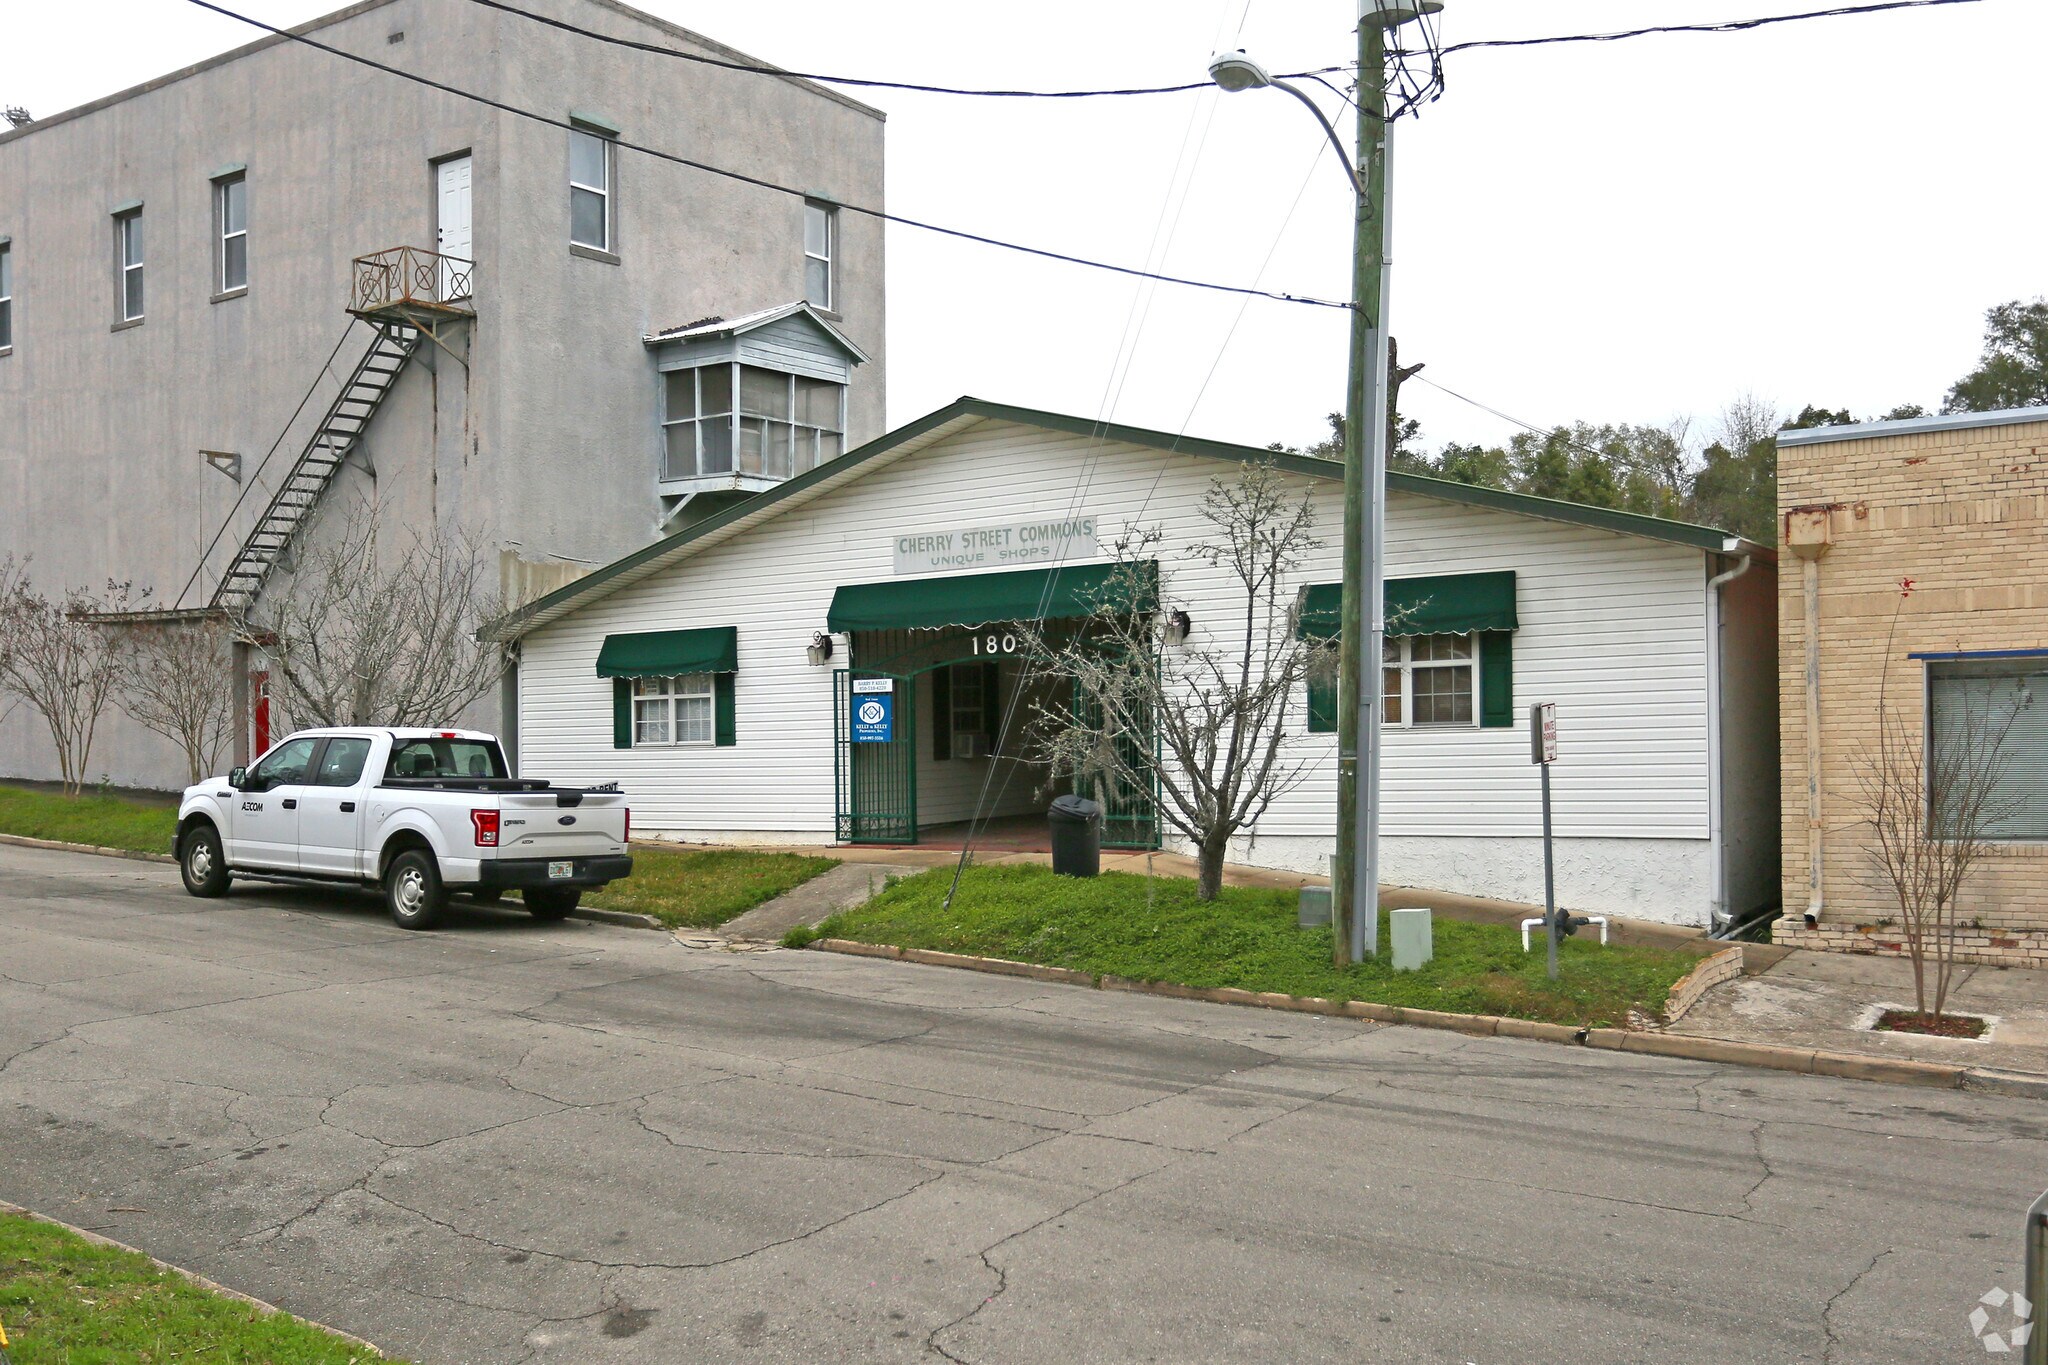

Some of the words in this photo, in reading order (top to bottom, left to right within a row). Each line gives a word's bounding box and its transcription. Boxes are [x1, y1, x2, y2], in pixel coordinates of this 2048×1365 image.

[899, 534, 953, 554] CHERRY
[962, 528, 1012, 549] STREET
[1019, 519, 1093, 543] COMMONS
[931, 552, 985, 566] UNIQUE
[999, 546, 1050, 559] SHOPS
[972, 634, 1016, 655] 180
[241, 801, 263, 812] AECOM
